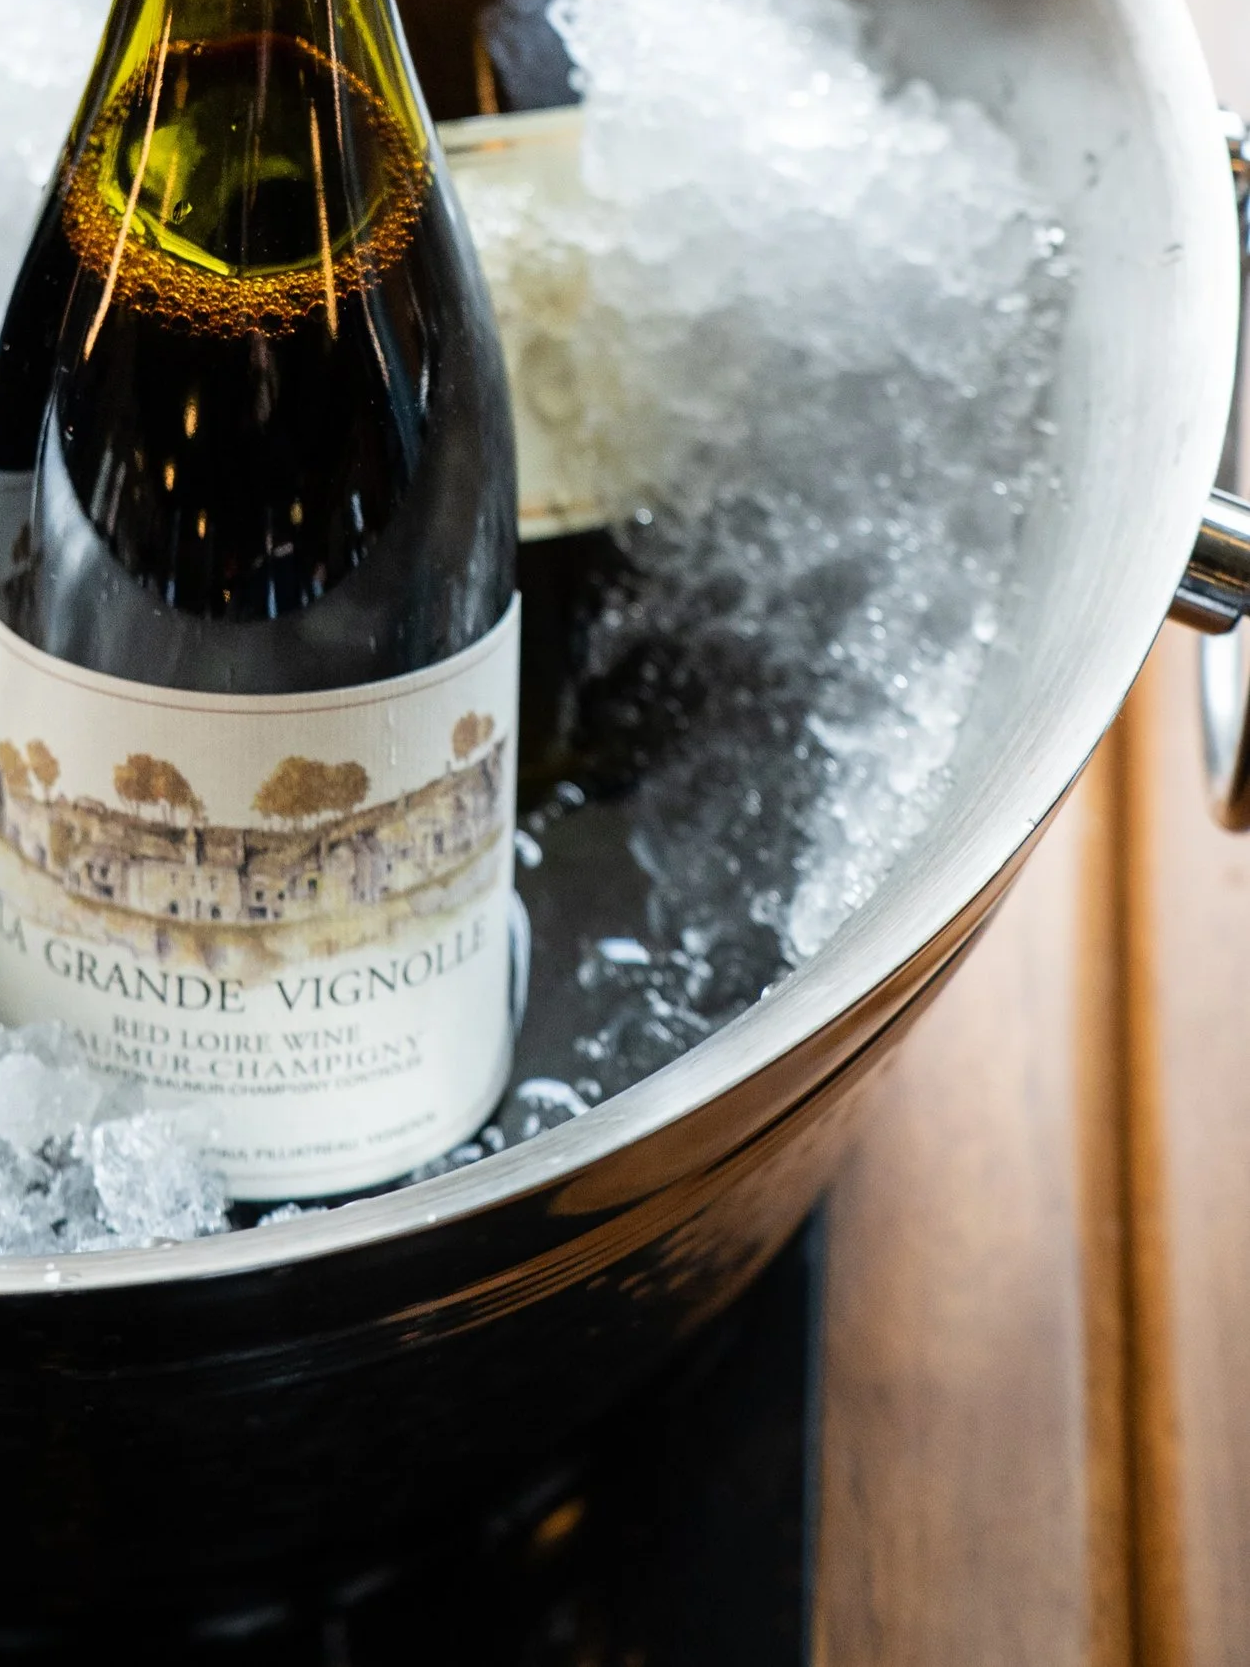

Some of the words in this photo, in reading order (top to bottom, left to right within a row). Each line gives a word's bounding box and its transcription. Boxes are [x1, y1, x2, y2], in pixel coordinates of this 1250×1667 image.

[43, 937, 245, 1013] GRANDE
[275, 913, 487, 1013] VIGNOLLE
[68, 1027, 425, 1079] AUMUR-CHAMPIGNY
[113, 1014, 170, 1045] RED
[181, 1027, 273, 1054] LOIRE
[282, 1022, 361, 1052] WINE
